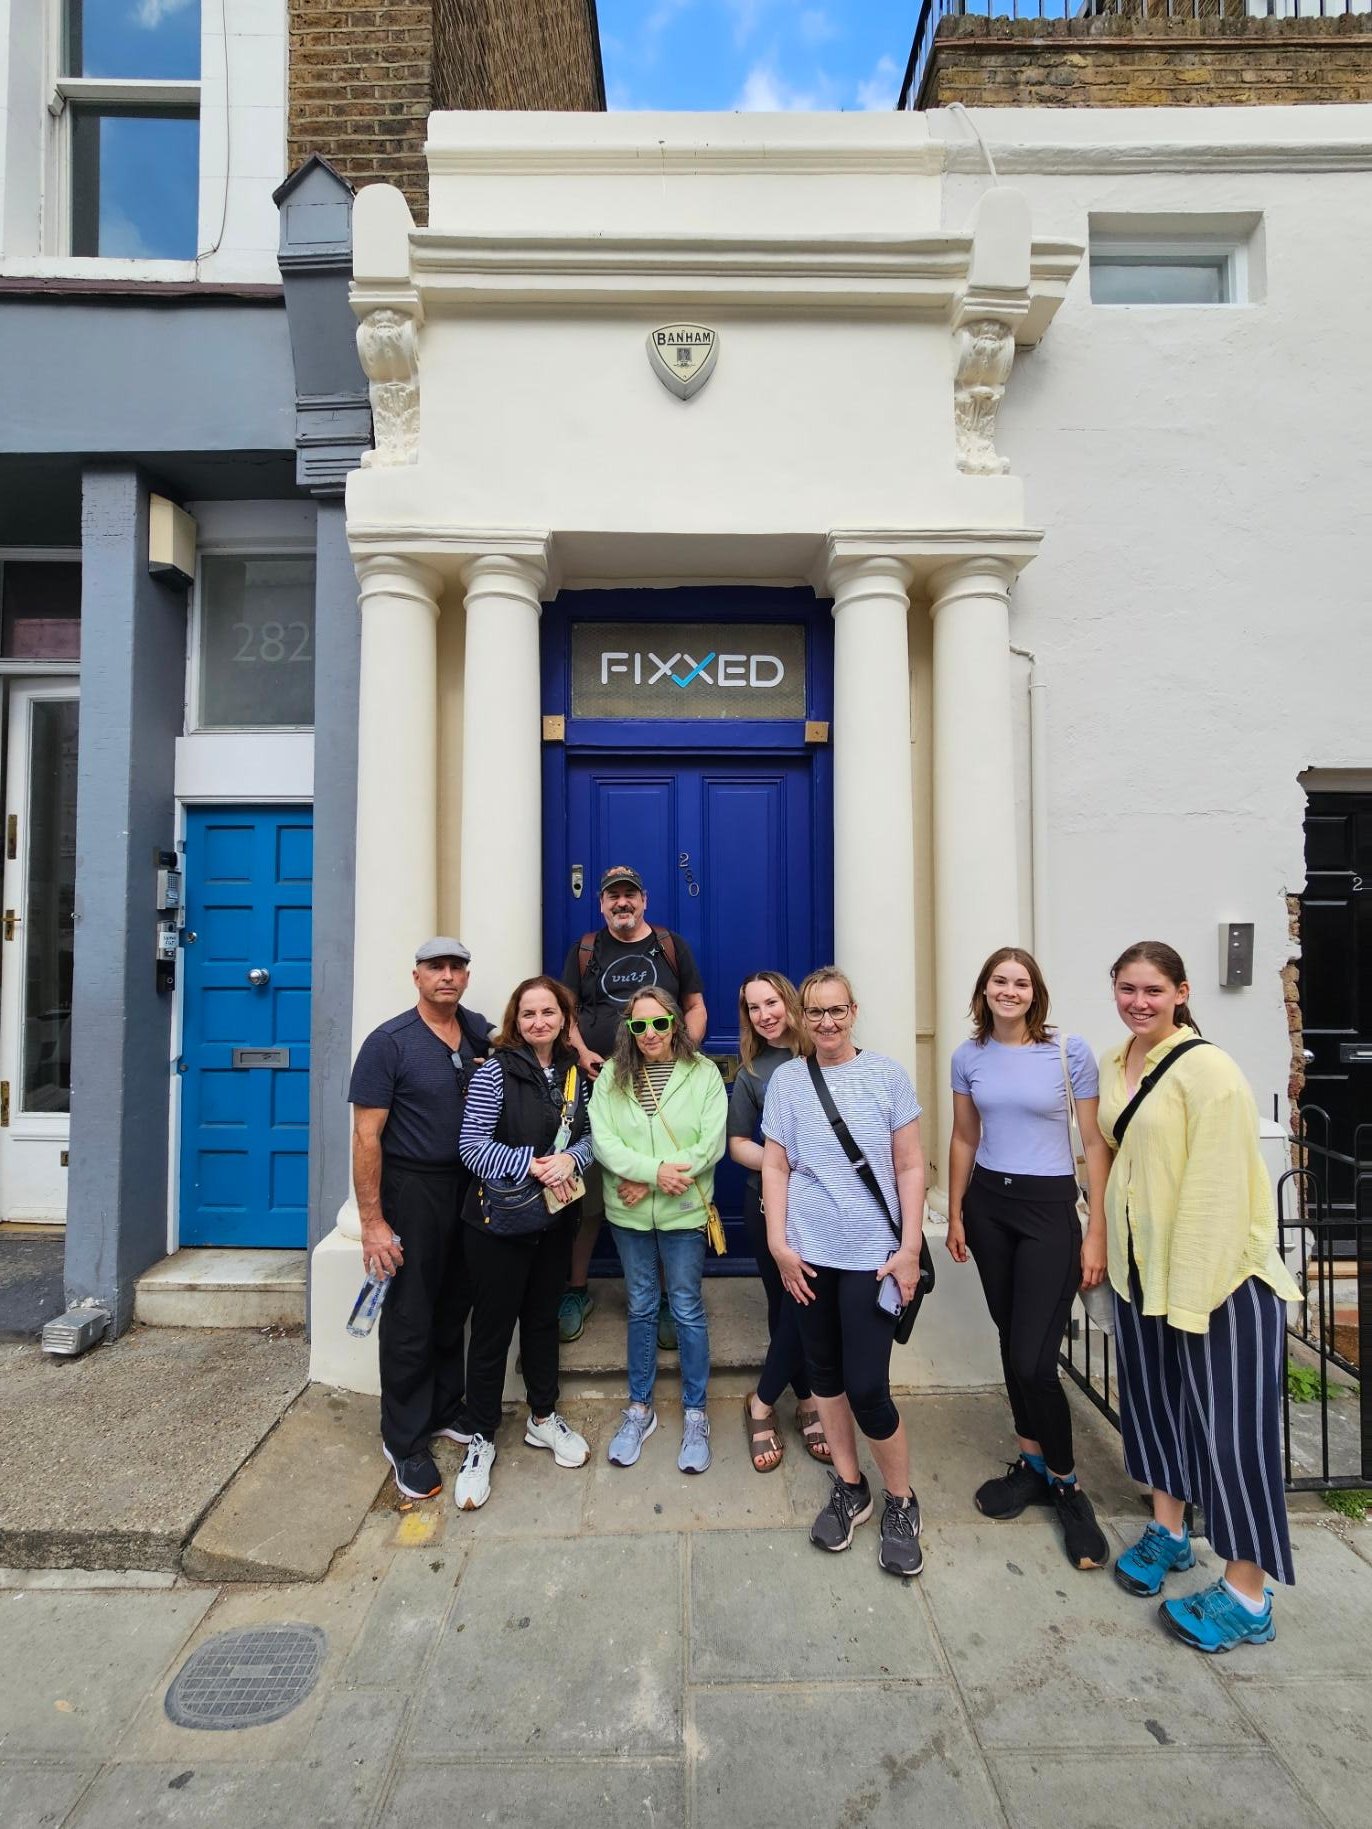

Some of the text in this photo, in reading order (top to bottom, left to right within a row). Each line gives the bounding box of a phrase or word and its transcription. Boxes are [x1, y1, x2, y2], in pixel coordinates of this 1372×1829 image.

[657, 332, 711, 346] BANHAM
[231, 621, 312, 662] 282
[601, 652, 785, 688] FIXXED
